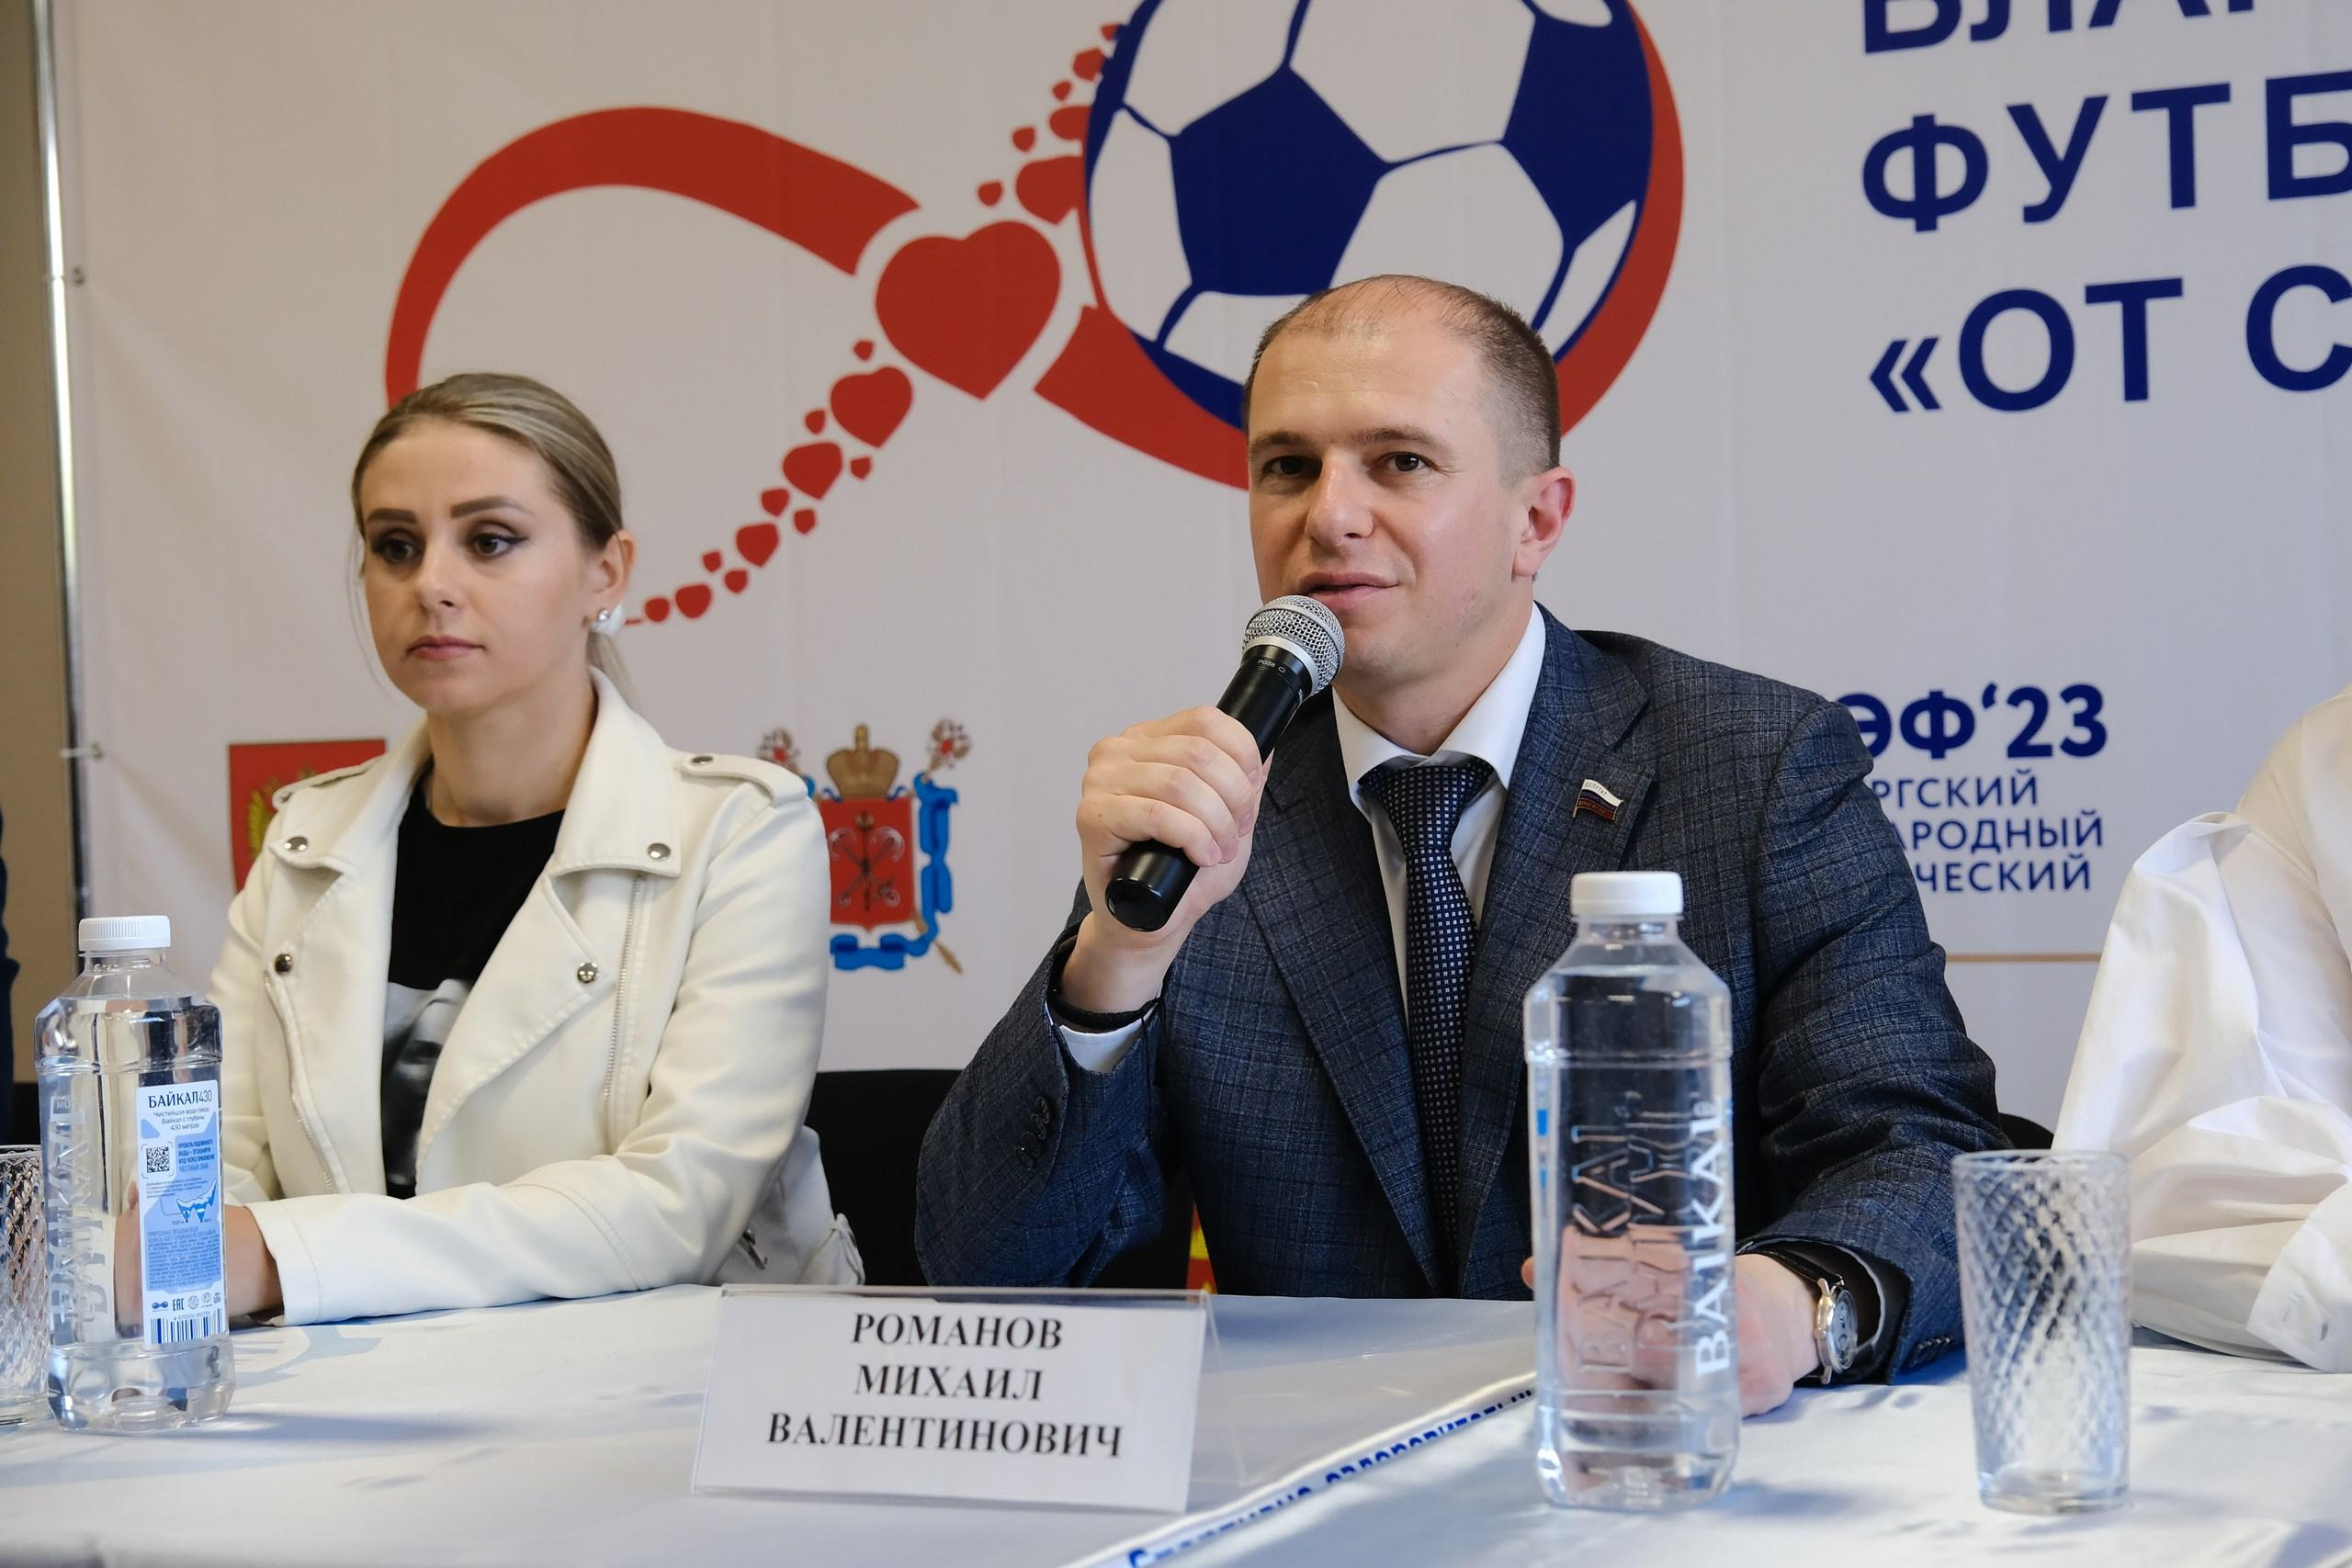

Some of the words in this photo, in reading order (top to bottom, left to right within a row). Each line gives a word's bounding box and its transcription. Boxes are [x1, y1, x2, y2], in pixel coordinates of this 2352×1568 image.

[1870, 276, 2183, 412] «ОТ
[1916, 853, 2089, 892] ЧЕСКИЙ
[1688, 1096, 1731, 1377] BAIKAL
[852, 1313, 1063, 1349] РОМАНОВ
[854, 1363, 1045, 1402] МИХАИЛ
[766, 1412, 1124, 1459] ВАЛЕНТИНОВИЧ
